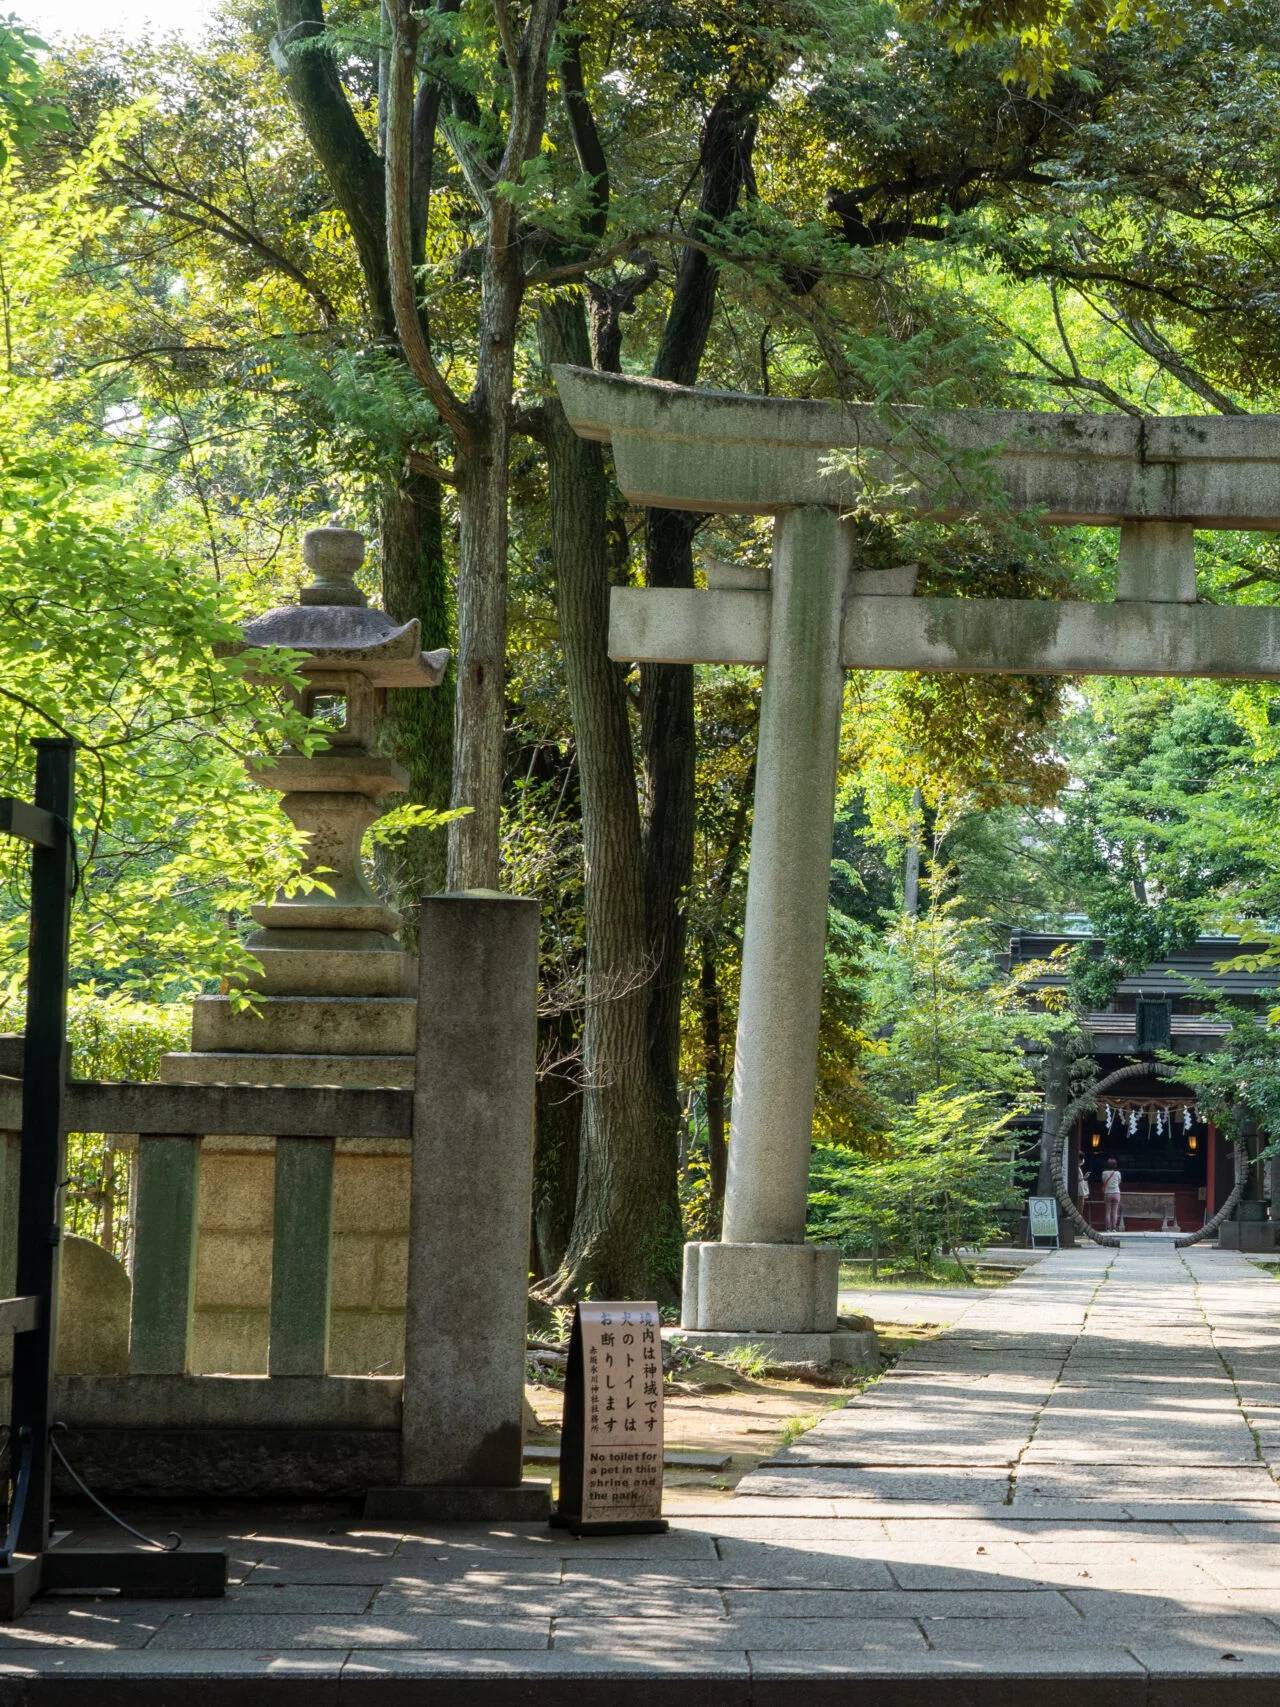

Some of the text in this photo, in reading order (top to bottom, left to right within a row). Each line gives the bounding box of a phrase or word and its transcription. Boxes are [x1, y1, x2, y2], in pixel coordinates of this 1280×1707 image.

[600, 1311, 617, 1433] お断りします
[620, 1311, 637, 1433] 犬のトイレは
[640, 1311, 659, 1433] 境内は神域です
[590, 1451, 658, 1461] No toilet for
[590, 1464, 657, 1476] a pet in this
[590, 1478, 656, 1488] shrine and
[589, 1492, 608, 1500] the
